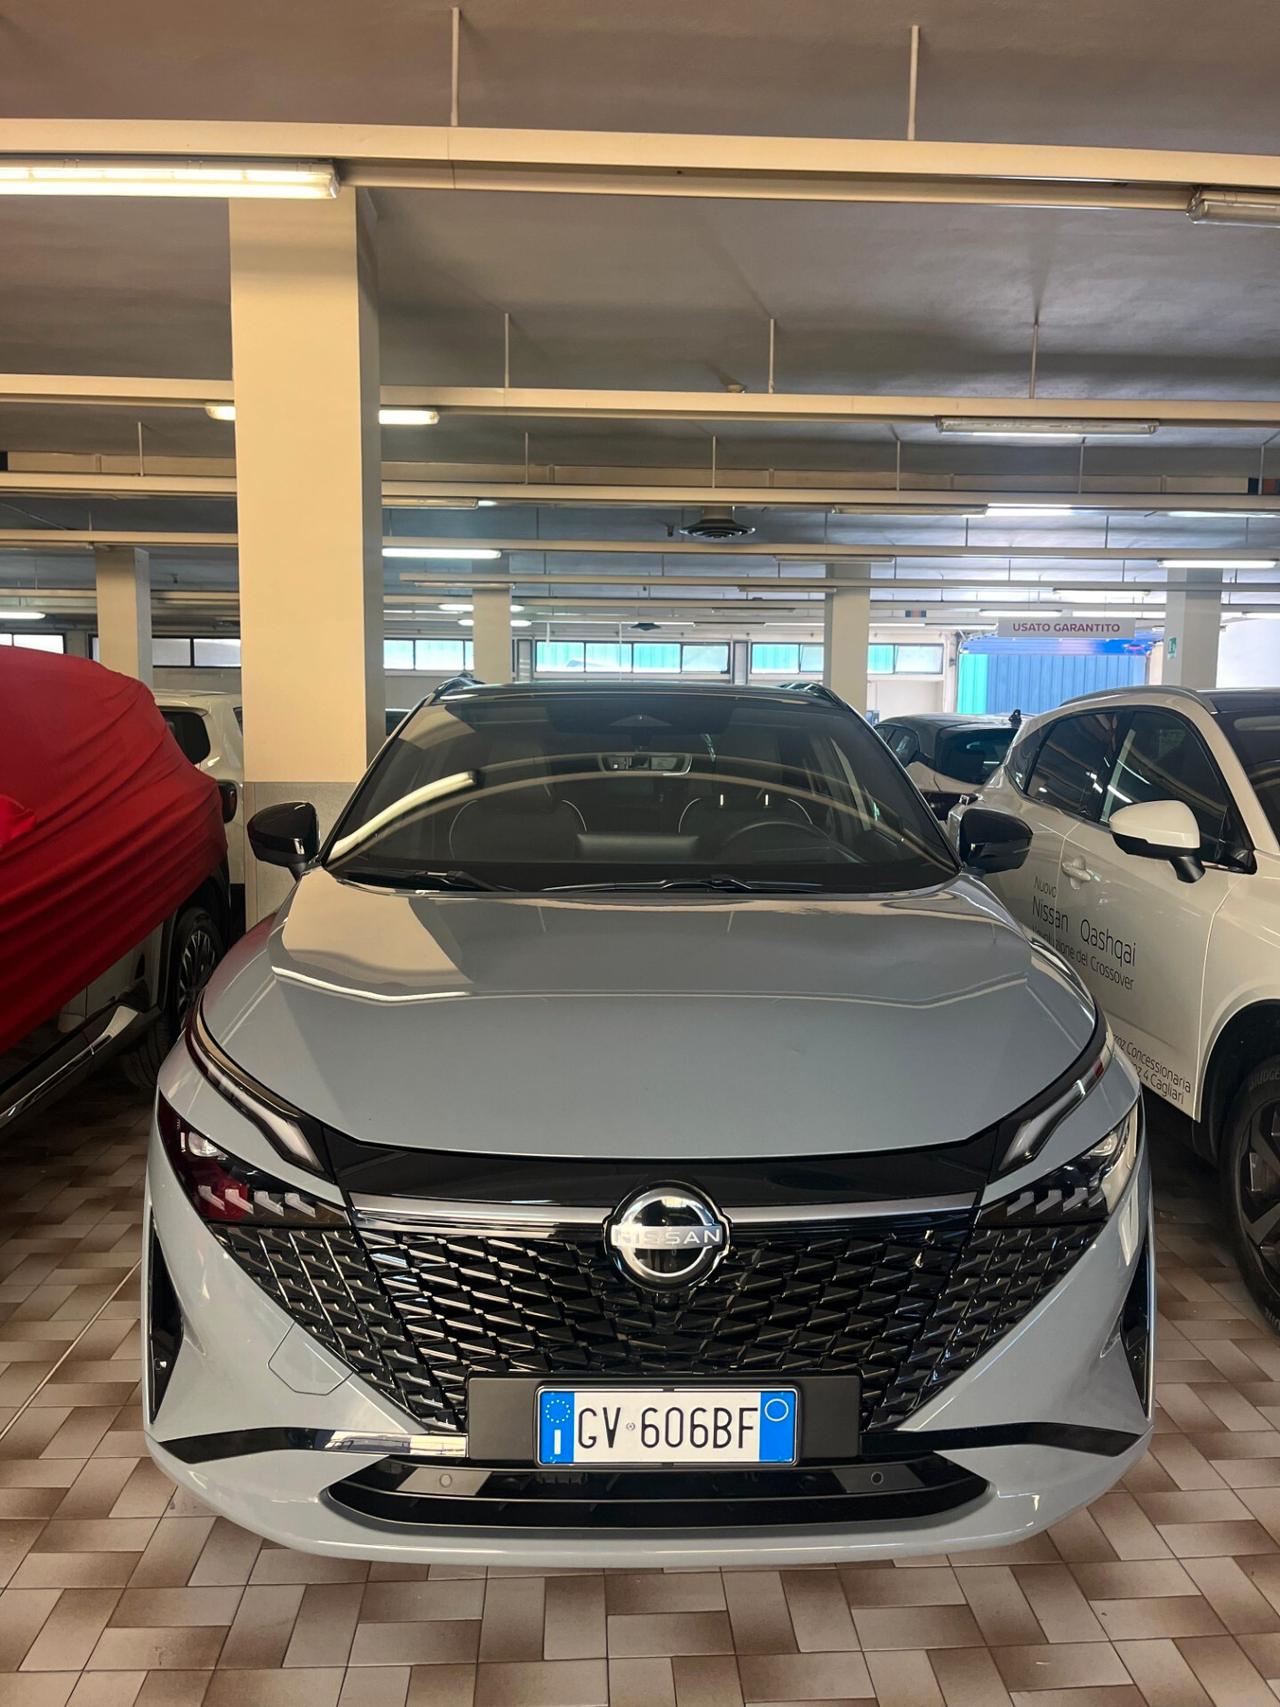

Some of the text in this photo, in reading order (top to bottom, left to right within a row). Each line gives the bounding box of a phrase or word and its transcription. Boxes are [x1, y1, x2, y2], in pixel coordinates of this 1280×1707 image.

[1012, 622, 1121, 633] USATO GARANTITO
[1033, 896, 1137, 967] Nissan Qashqai
[1090, 955, 1135, 990] Crossover
[1127, 1042, 1191, 1093] Concessionaria
[1150, 1073, 1184, 1104] Cagliari
[613, 1229, 720, 1246] NISSAN
[578, 1407, 759, 1449] GV 606BF
